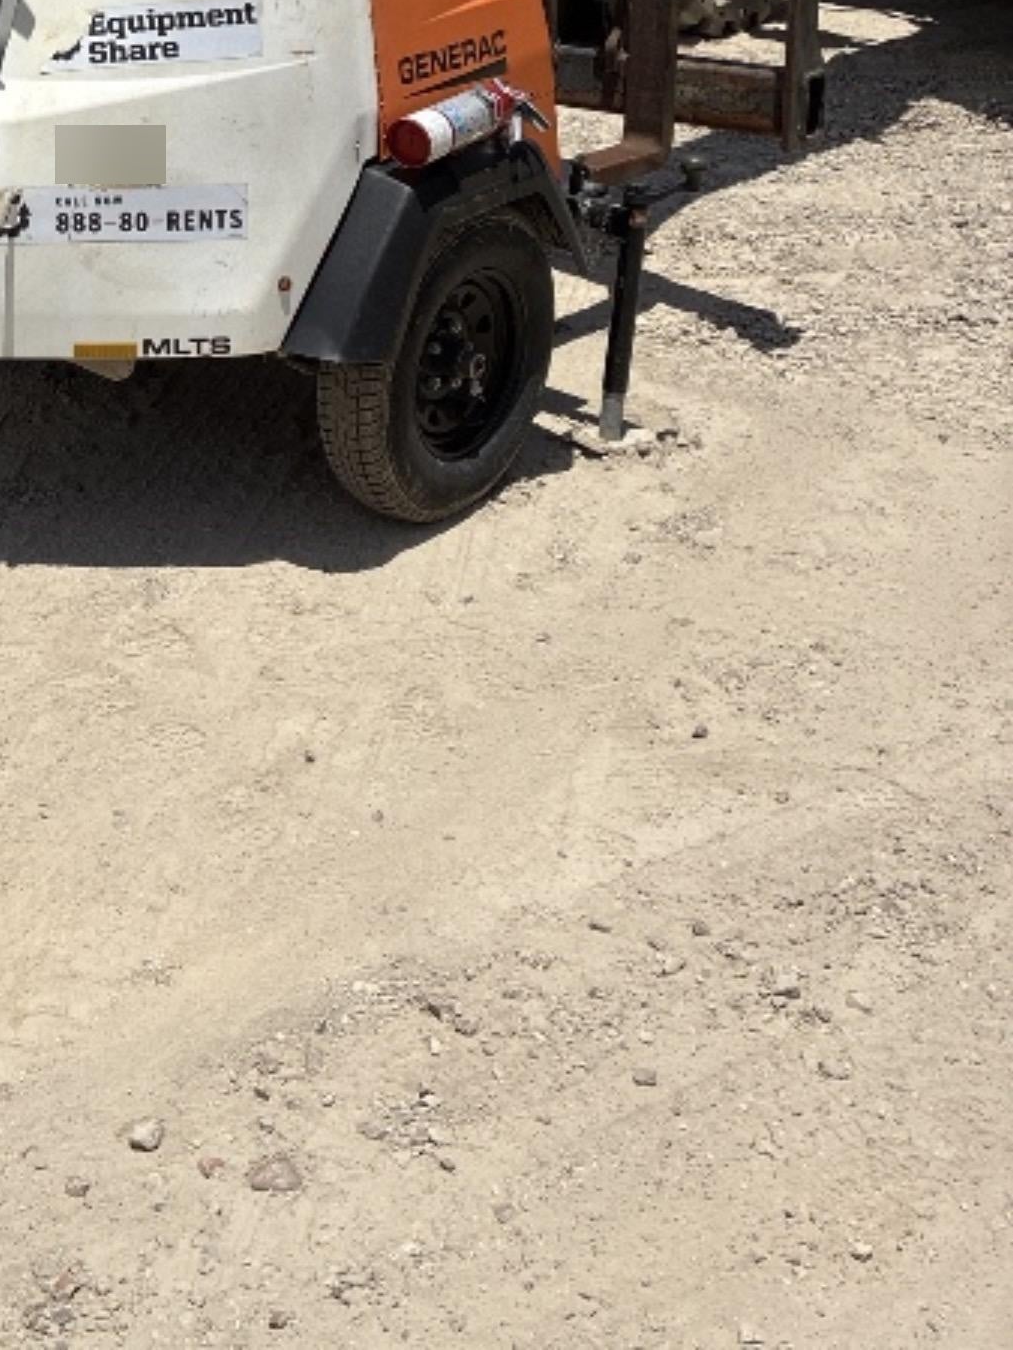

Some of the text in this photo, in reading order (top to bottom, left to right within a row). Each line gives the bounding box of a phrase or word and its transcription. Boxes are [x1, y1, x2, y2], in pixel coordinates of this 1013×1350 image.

[88, 1, 258, 39] Equipment
[88, 40, 180, 64] Share
[398, 29, 507, 84] GENERAC
[142, 336, 231, 356] MLTS
